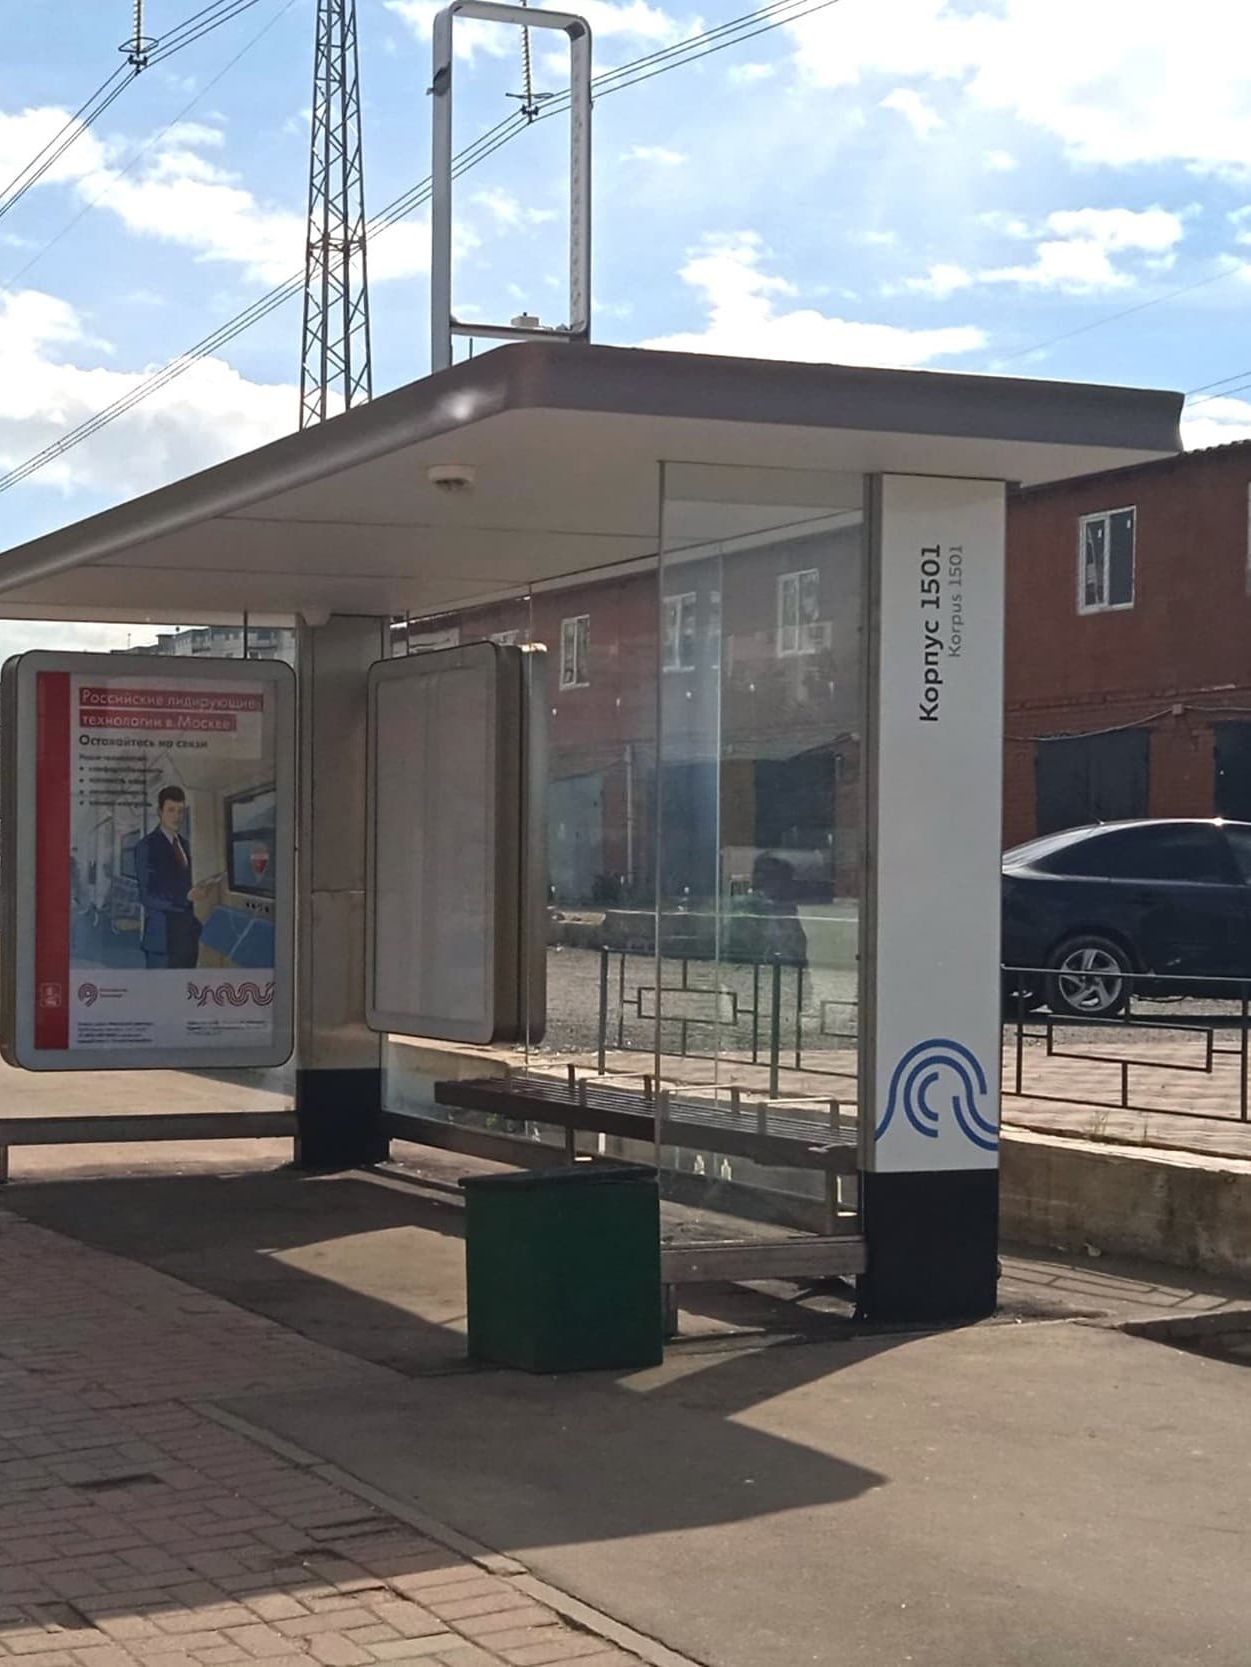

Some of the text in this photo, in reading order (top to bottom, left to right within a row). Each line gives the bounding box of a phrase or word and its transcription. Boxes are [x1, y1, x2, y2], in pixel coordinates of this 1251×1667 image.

[919, 544, 943, 721] Корпус 1501
[948, 545, 964, 657] Korpus 1501
[82, 689, 164, 706] Российские
